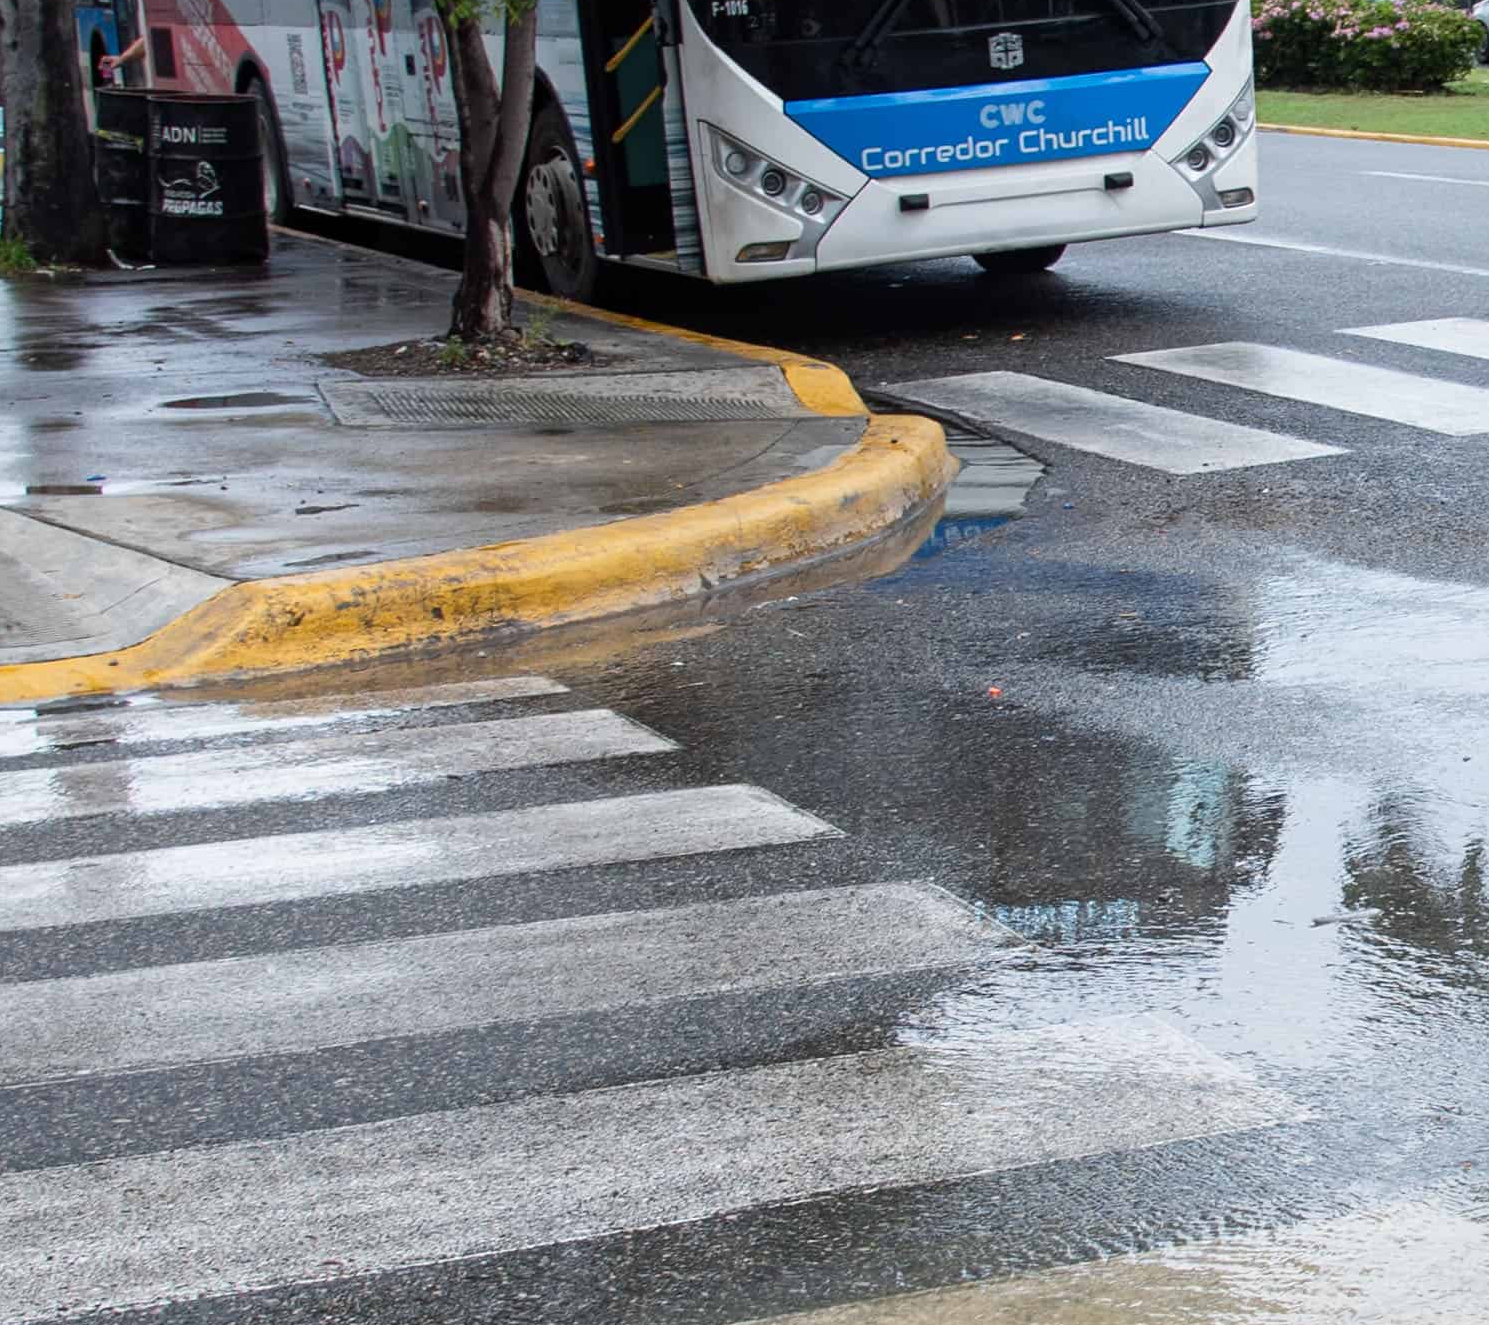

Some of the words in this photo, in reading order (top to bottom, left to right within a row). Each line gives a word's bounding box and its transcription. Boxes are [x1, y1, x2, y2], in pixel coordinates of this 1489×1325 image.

[979, 100, 1046, 128] CWC
[162, 126, 196, 144] ADN
[862, 136, 1009, 170] Corredor
[1018, 116, 1149, 154] Churchill
